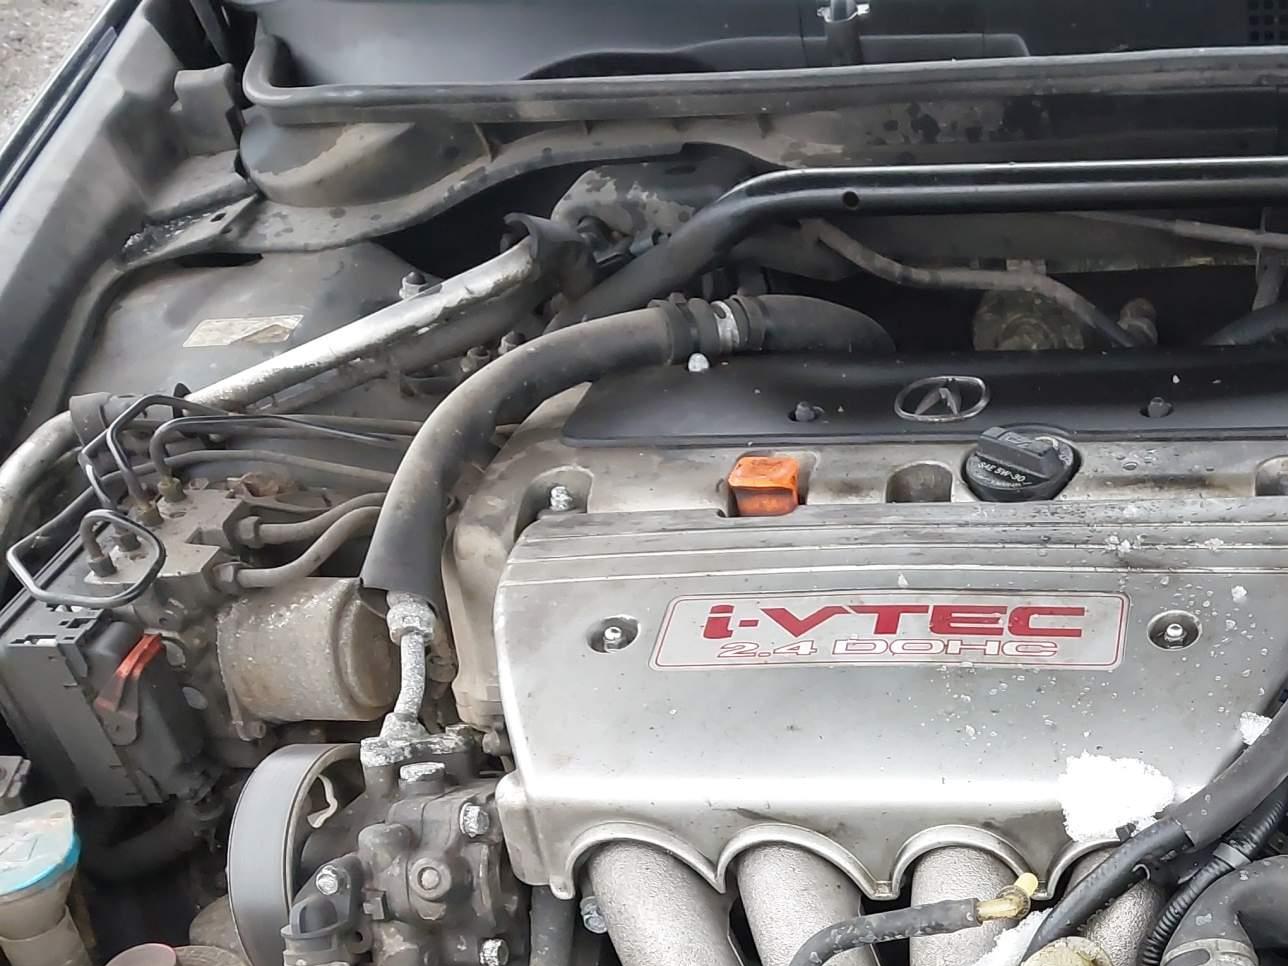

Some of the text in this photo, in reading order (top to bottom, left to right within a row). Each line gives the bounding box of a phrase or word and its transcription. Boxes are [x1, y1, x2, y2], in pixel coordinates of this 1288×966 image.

[702, 603, 1085, 639] i-VTEC
[717, 638, 1059, 658] 2.4 DOHC
